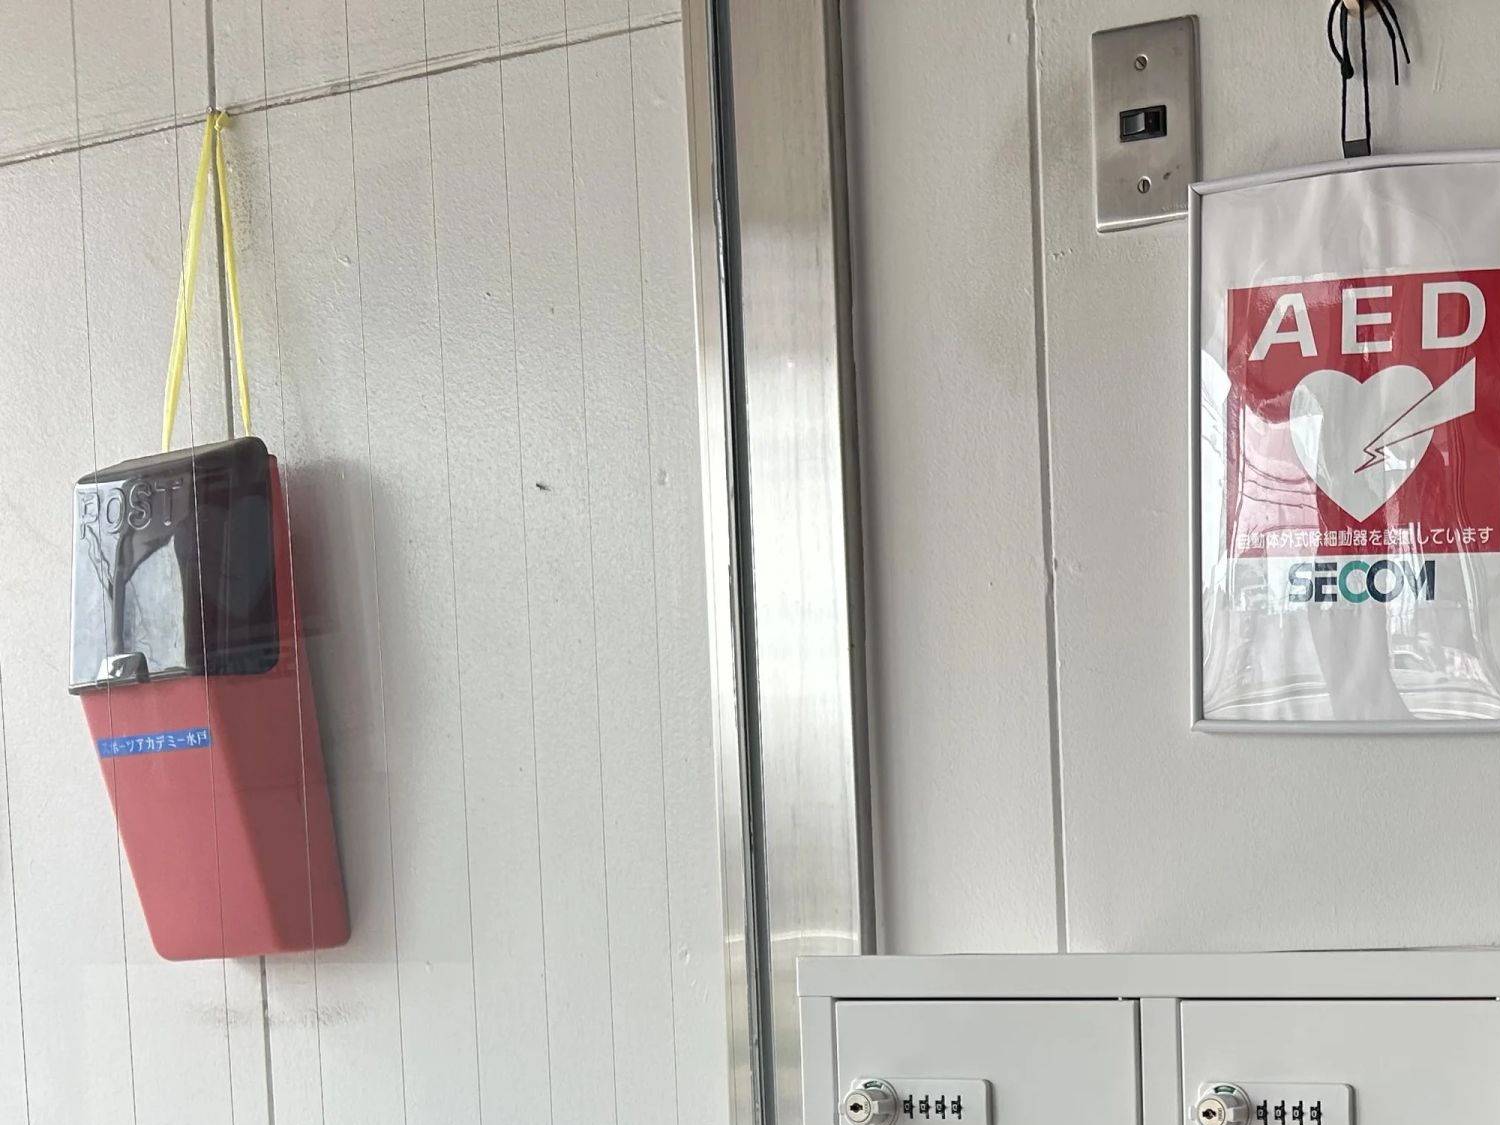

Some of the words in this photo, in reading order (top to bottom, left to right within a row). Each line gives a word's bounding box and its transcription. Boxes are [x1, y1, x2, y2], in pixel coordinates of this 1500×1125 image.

[1248, 281, 1486, 361] AED
[78, 476, 184, 540] POST
[1288, 559, 1436, 604] SECOM
